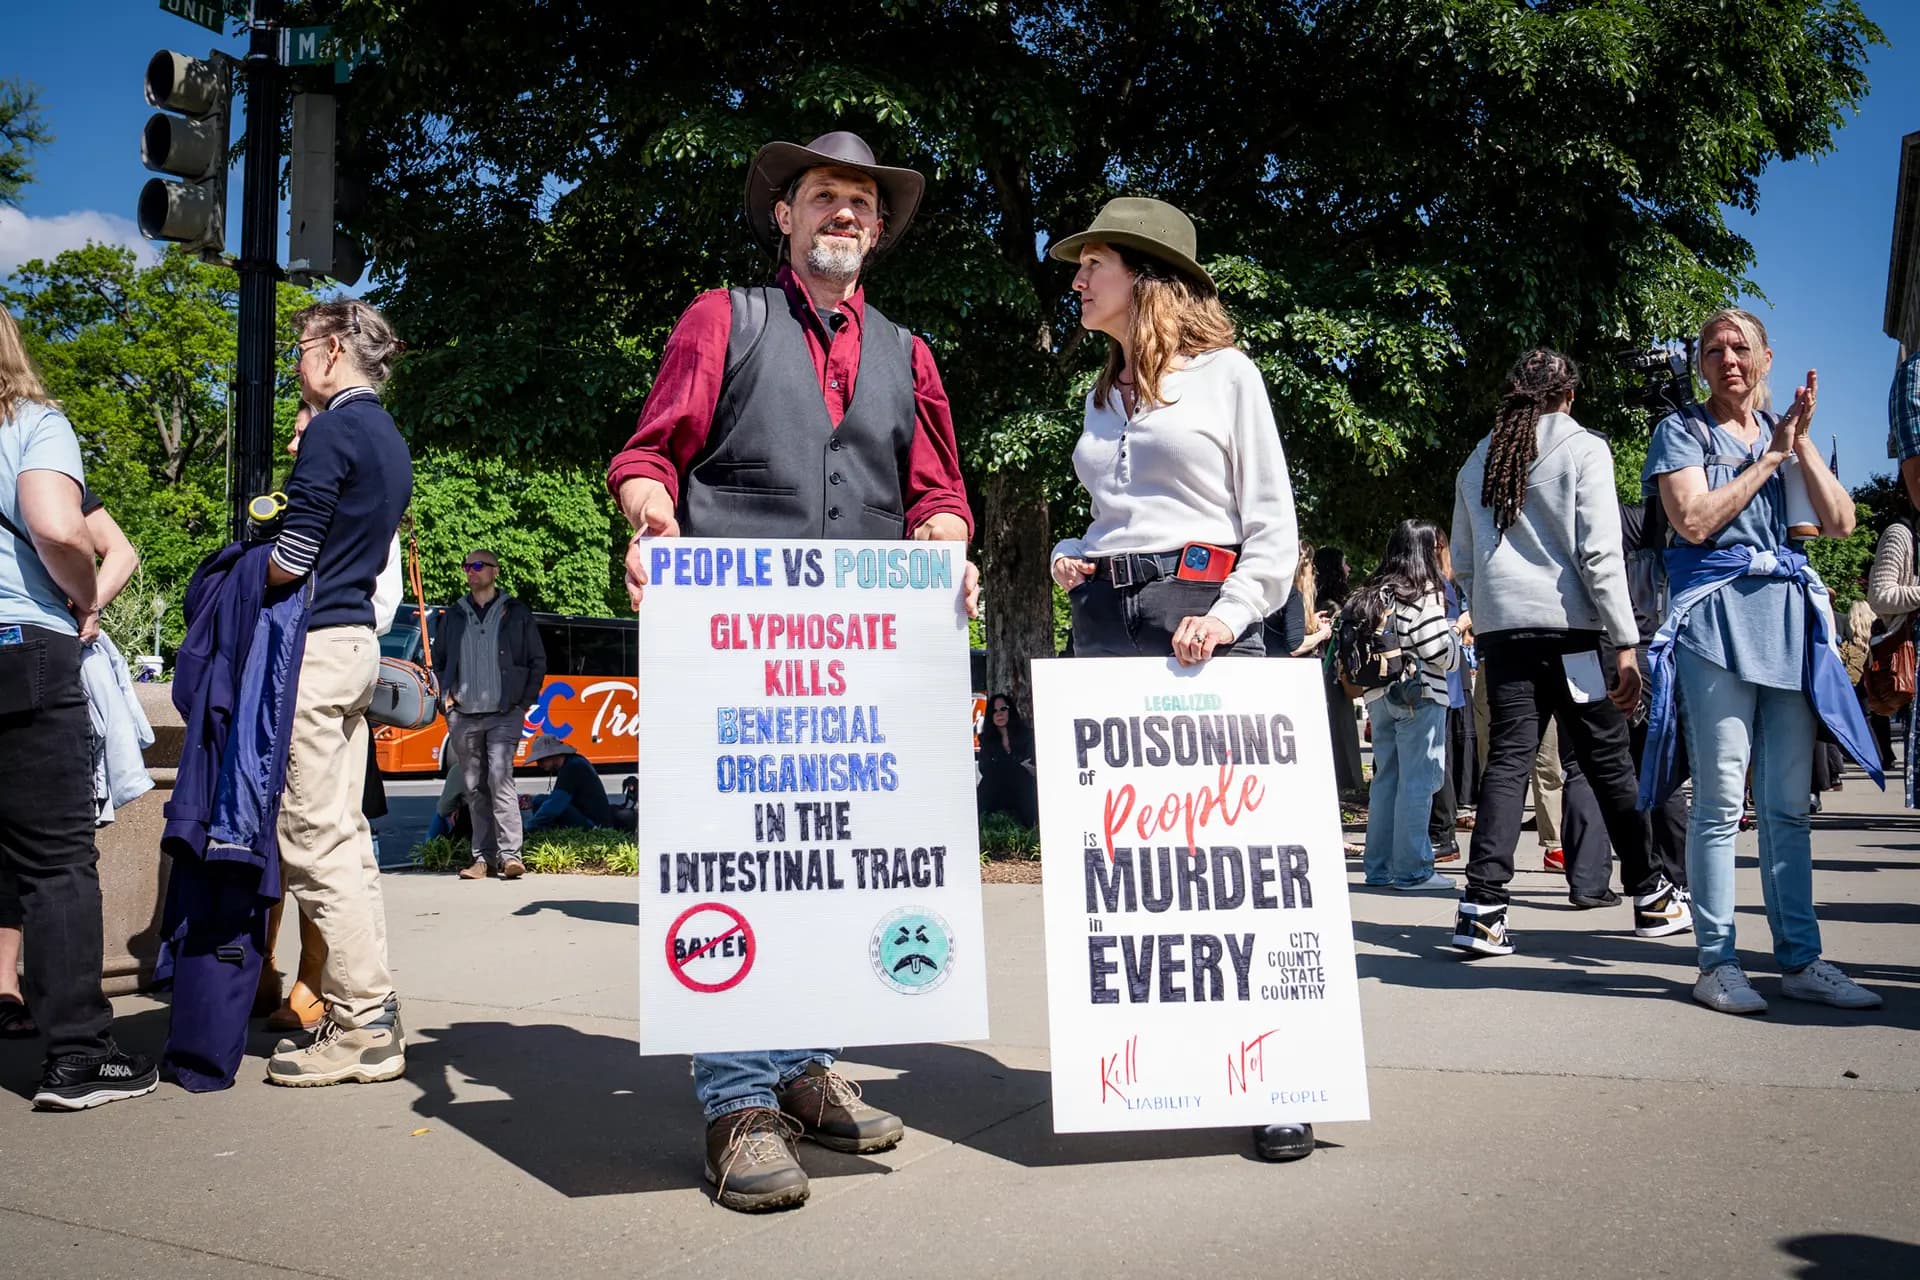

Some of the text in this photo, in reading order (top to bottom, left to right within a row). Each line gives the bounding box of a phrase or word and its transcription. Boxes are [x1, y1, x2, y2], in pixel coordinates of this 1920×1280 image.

[651, 548, 952, 589] PEOPLE VS POISON
[710, 613, 897, 650] GLYPHOSATE
[764, 659, 847, 697] KILLS
[1144, 694, 1222, 712] LEGALIZED
[717, 706, 886, 745] BENEFICIAL
[1073, 714, 1297, 768] POISONING
[716, 752, 899, 793] ORGANISMS
[1078, 769, 1097, 786] of
[754, 801, 852, 843] IN THE
[1104, 749, 1265, 863] People
[1084, 831, 1097, 847] is
[659, 846, 948, 894] INTESTINAL TRACT
[1084, 844, 1313, 914] MURDER
[1089, 917, 1103, 933] in
[1289, 932, 1319, 949] CITY
[674, 934, 748, 962] BAYER
[1268, 950, 1322, 968] COUNTY
[1088, 933, 1255, 1004] EVERY
[1280, 967, 1326, 984] STATE
[1261, 983, 1326, 1001] COUNTRY
[99, 1063, 133, 1078] HOKA
[1127, 1090, 1328, 1111] LIABILITY PEOPLE
